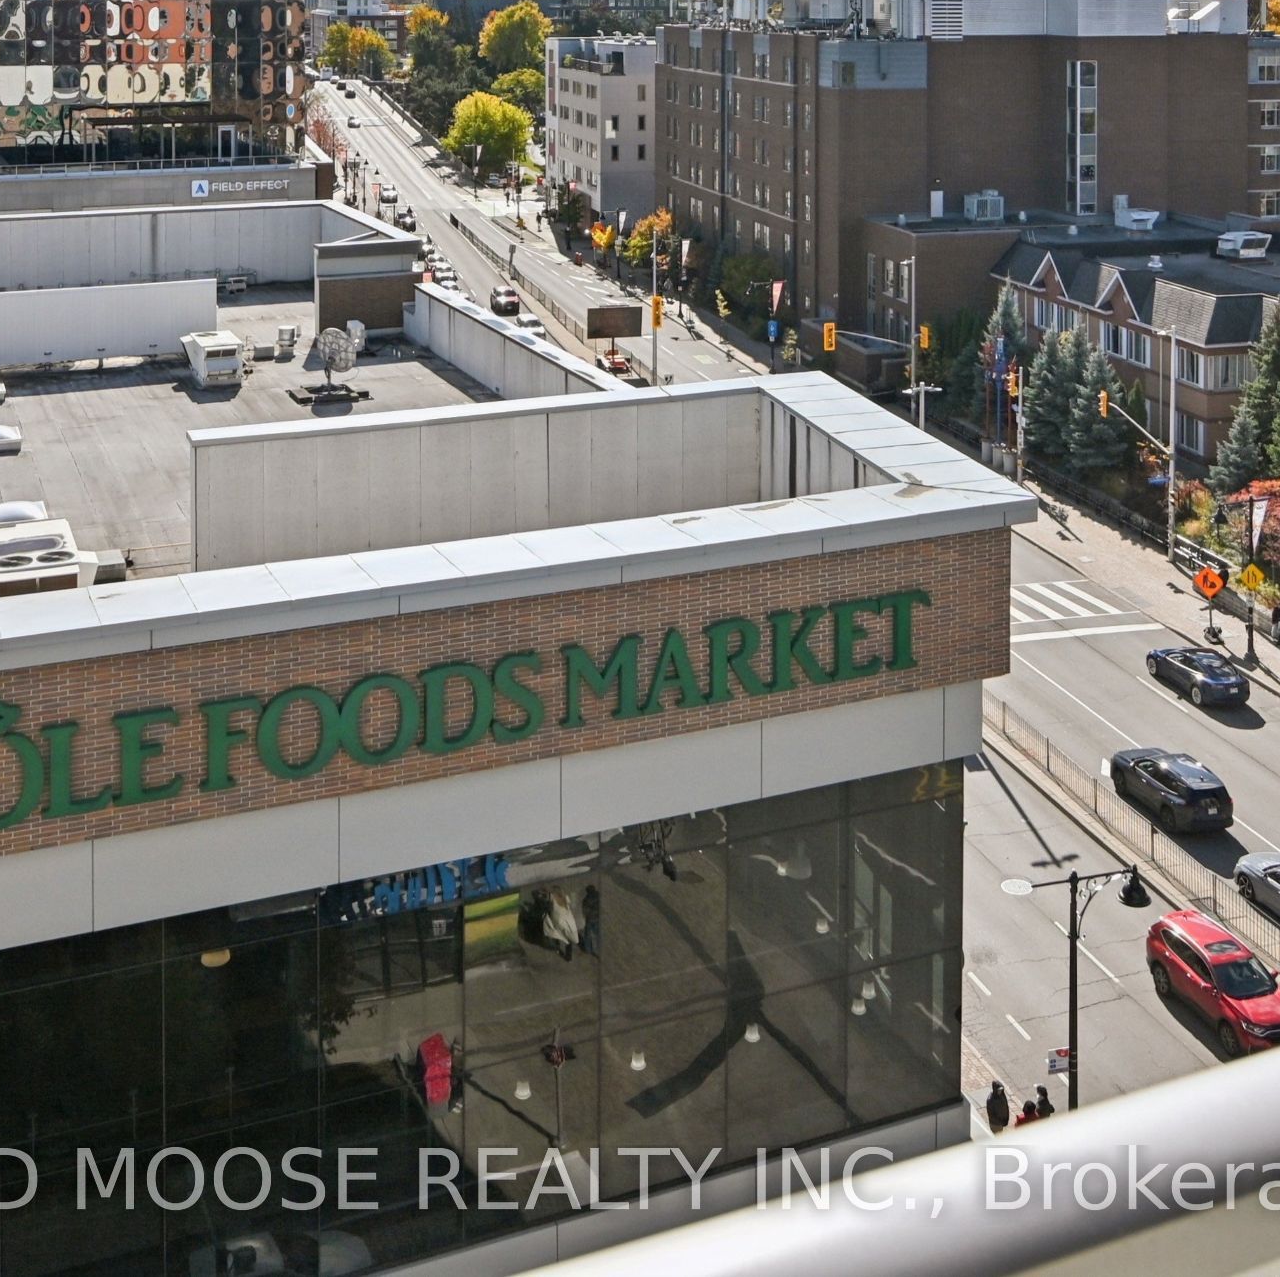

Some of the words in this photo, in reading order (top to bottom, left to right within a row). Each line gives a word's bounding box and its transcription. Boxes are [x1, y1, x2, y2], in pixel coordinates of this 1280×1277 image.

[212, 182, 243, 192] FIELD
[246, 179, 290, 191] EFFECT
[198, 650, 546, 793] FOODS
[559, 589, 932, 729] MARKET
